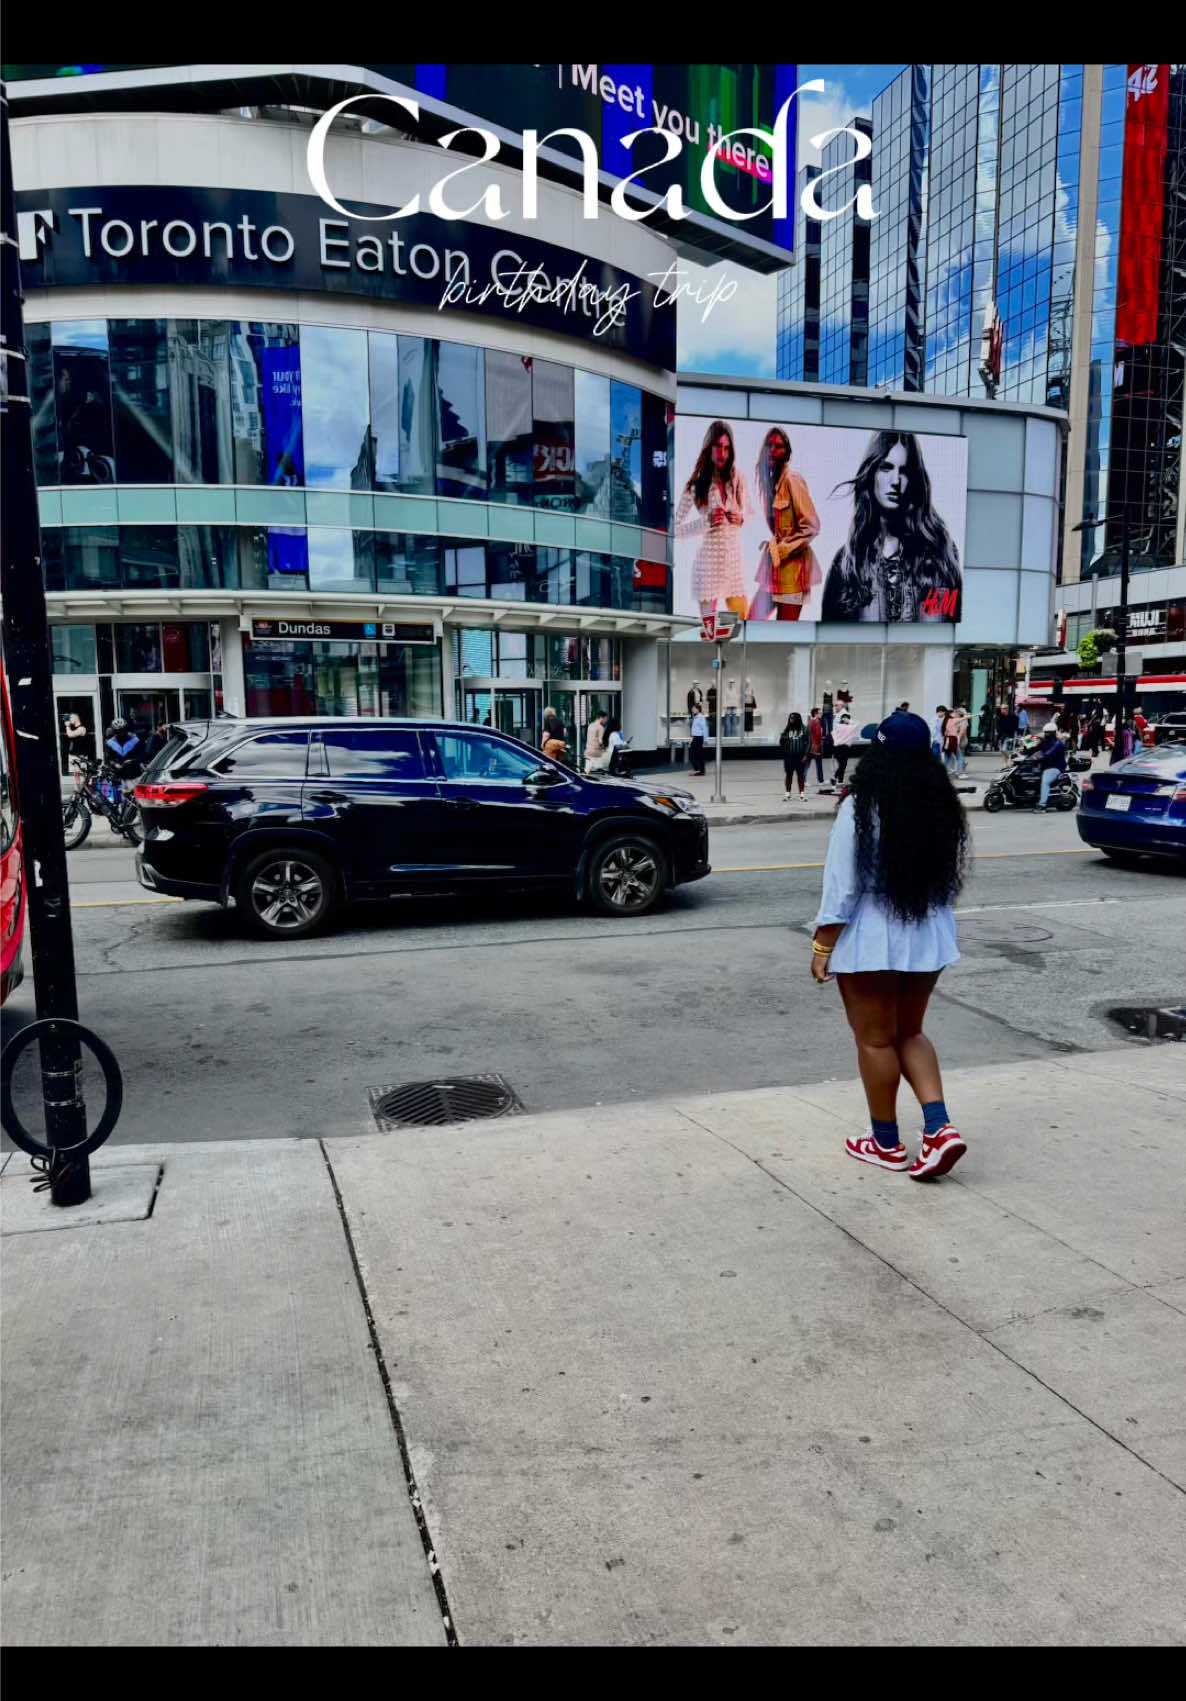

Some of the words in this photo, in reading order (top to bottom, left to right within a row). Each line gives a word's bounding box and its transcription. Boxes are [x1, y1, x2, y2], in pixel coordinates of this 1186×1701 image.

[571, 64, 645, 119] Meet
[652, 99, 700, 144] you
[708, 123, 769, 177] there
[68, 207, 296, 263] Toronto
[318, 218, 471, 285] Eaton
[490, 249, 629, 328] Centre
[278, 622, 331, 635] Dundas
